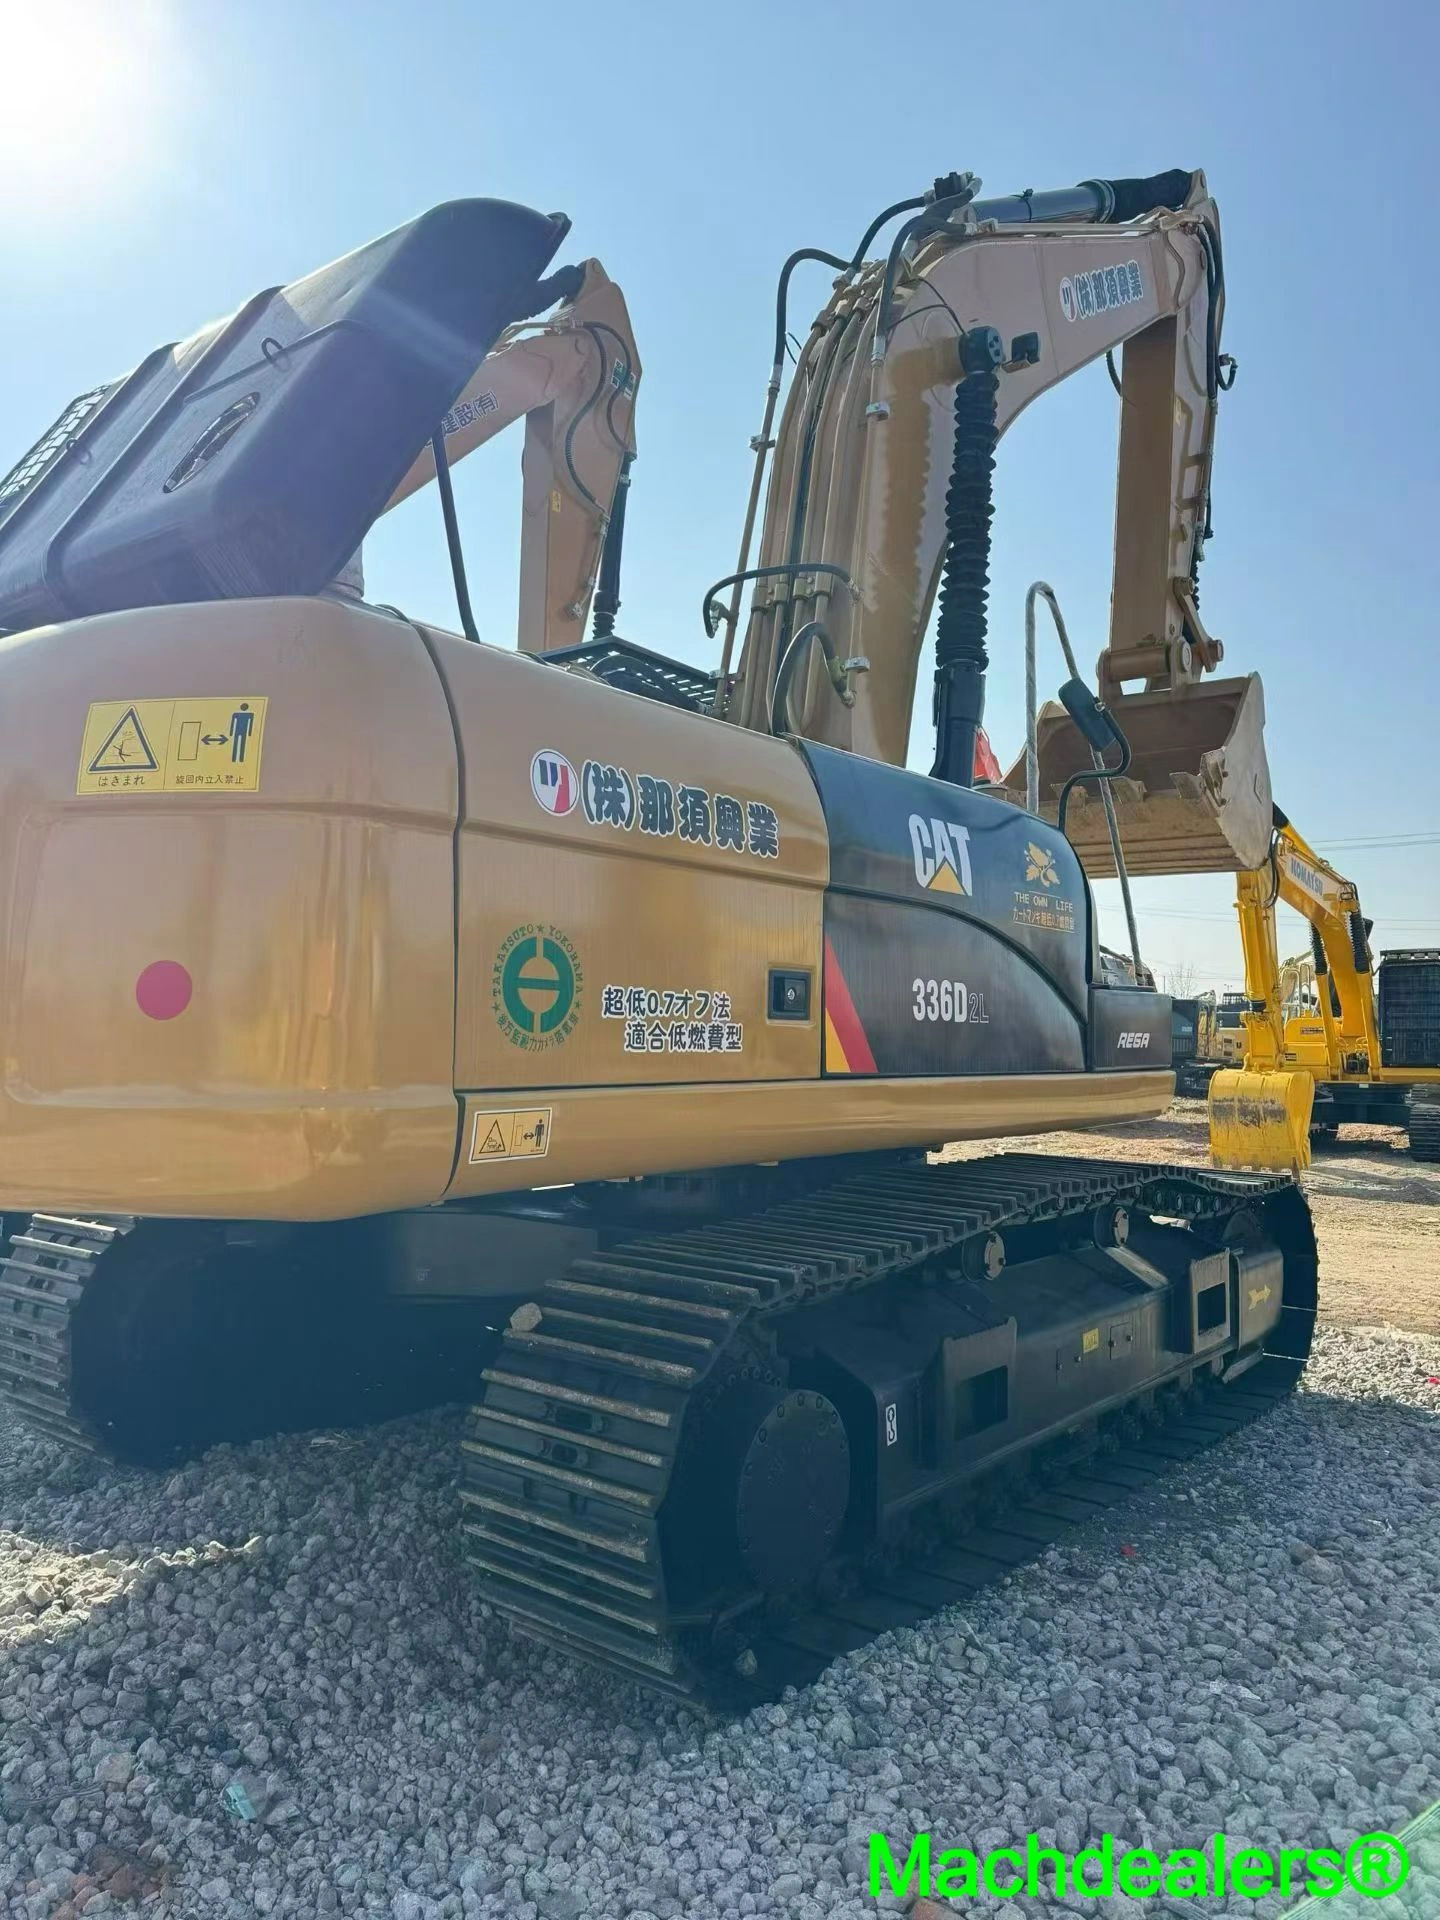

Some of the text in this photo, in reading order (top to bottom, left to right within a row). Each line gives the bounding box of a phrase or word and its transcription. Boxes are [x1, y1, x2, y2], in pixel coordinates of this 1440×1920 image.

[908, 814, 972, 897] CAT
[1291, 857, 1323, 897] KOMATSU
[1014, 891, 1030, 904] THE
[1055, 899, 1074, 912] LIFE
[624, 1020, 744, 1053] 適合低燃費型
